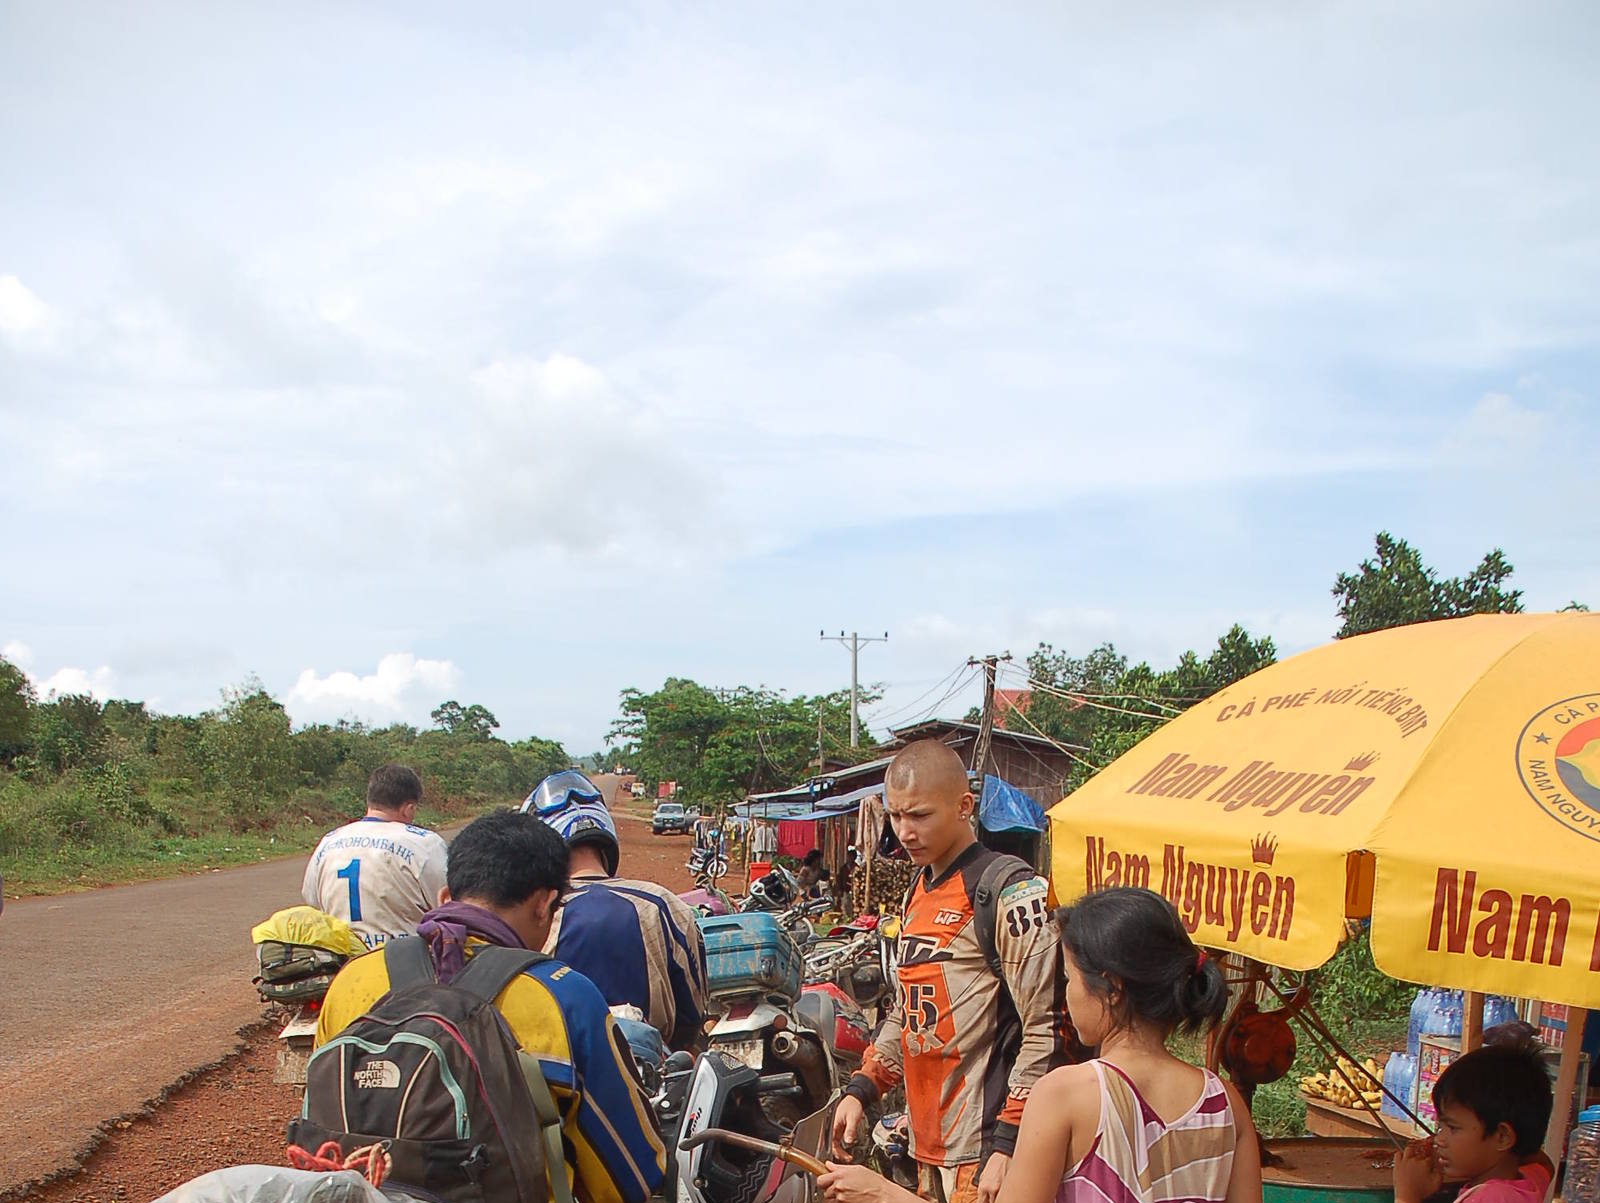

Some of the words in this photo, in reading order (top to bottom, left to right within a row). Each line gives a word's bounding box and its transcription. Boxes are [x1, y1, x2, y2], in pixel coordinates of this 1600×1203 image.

[1585, 701, 1599, 713] P
[1125, 752, 1229, 800] Nam
[1529, 759, 1556, 792] NAM
[1546, 793, 1600, 834] NGUY
[337, 859, 363, 922] 1
[934, 908, 963, 925] WP
[1427, 867, 1572, 968] Nam
[366, 1061, 384, 1070] THE
[353, 1070, 385, 1080] NORTH
[358, 1079, 384, 1089] FACE
